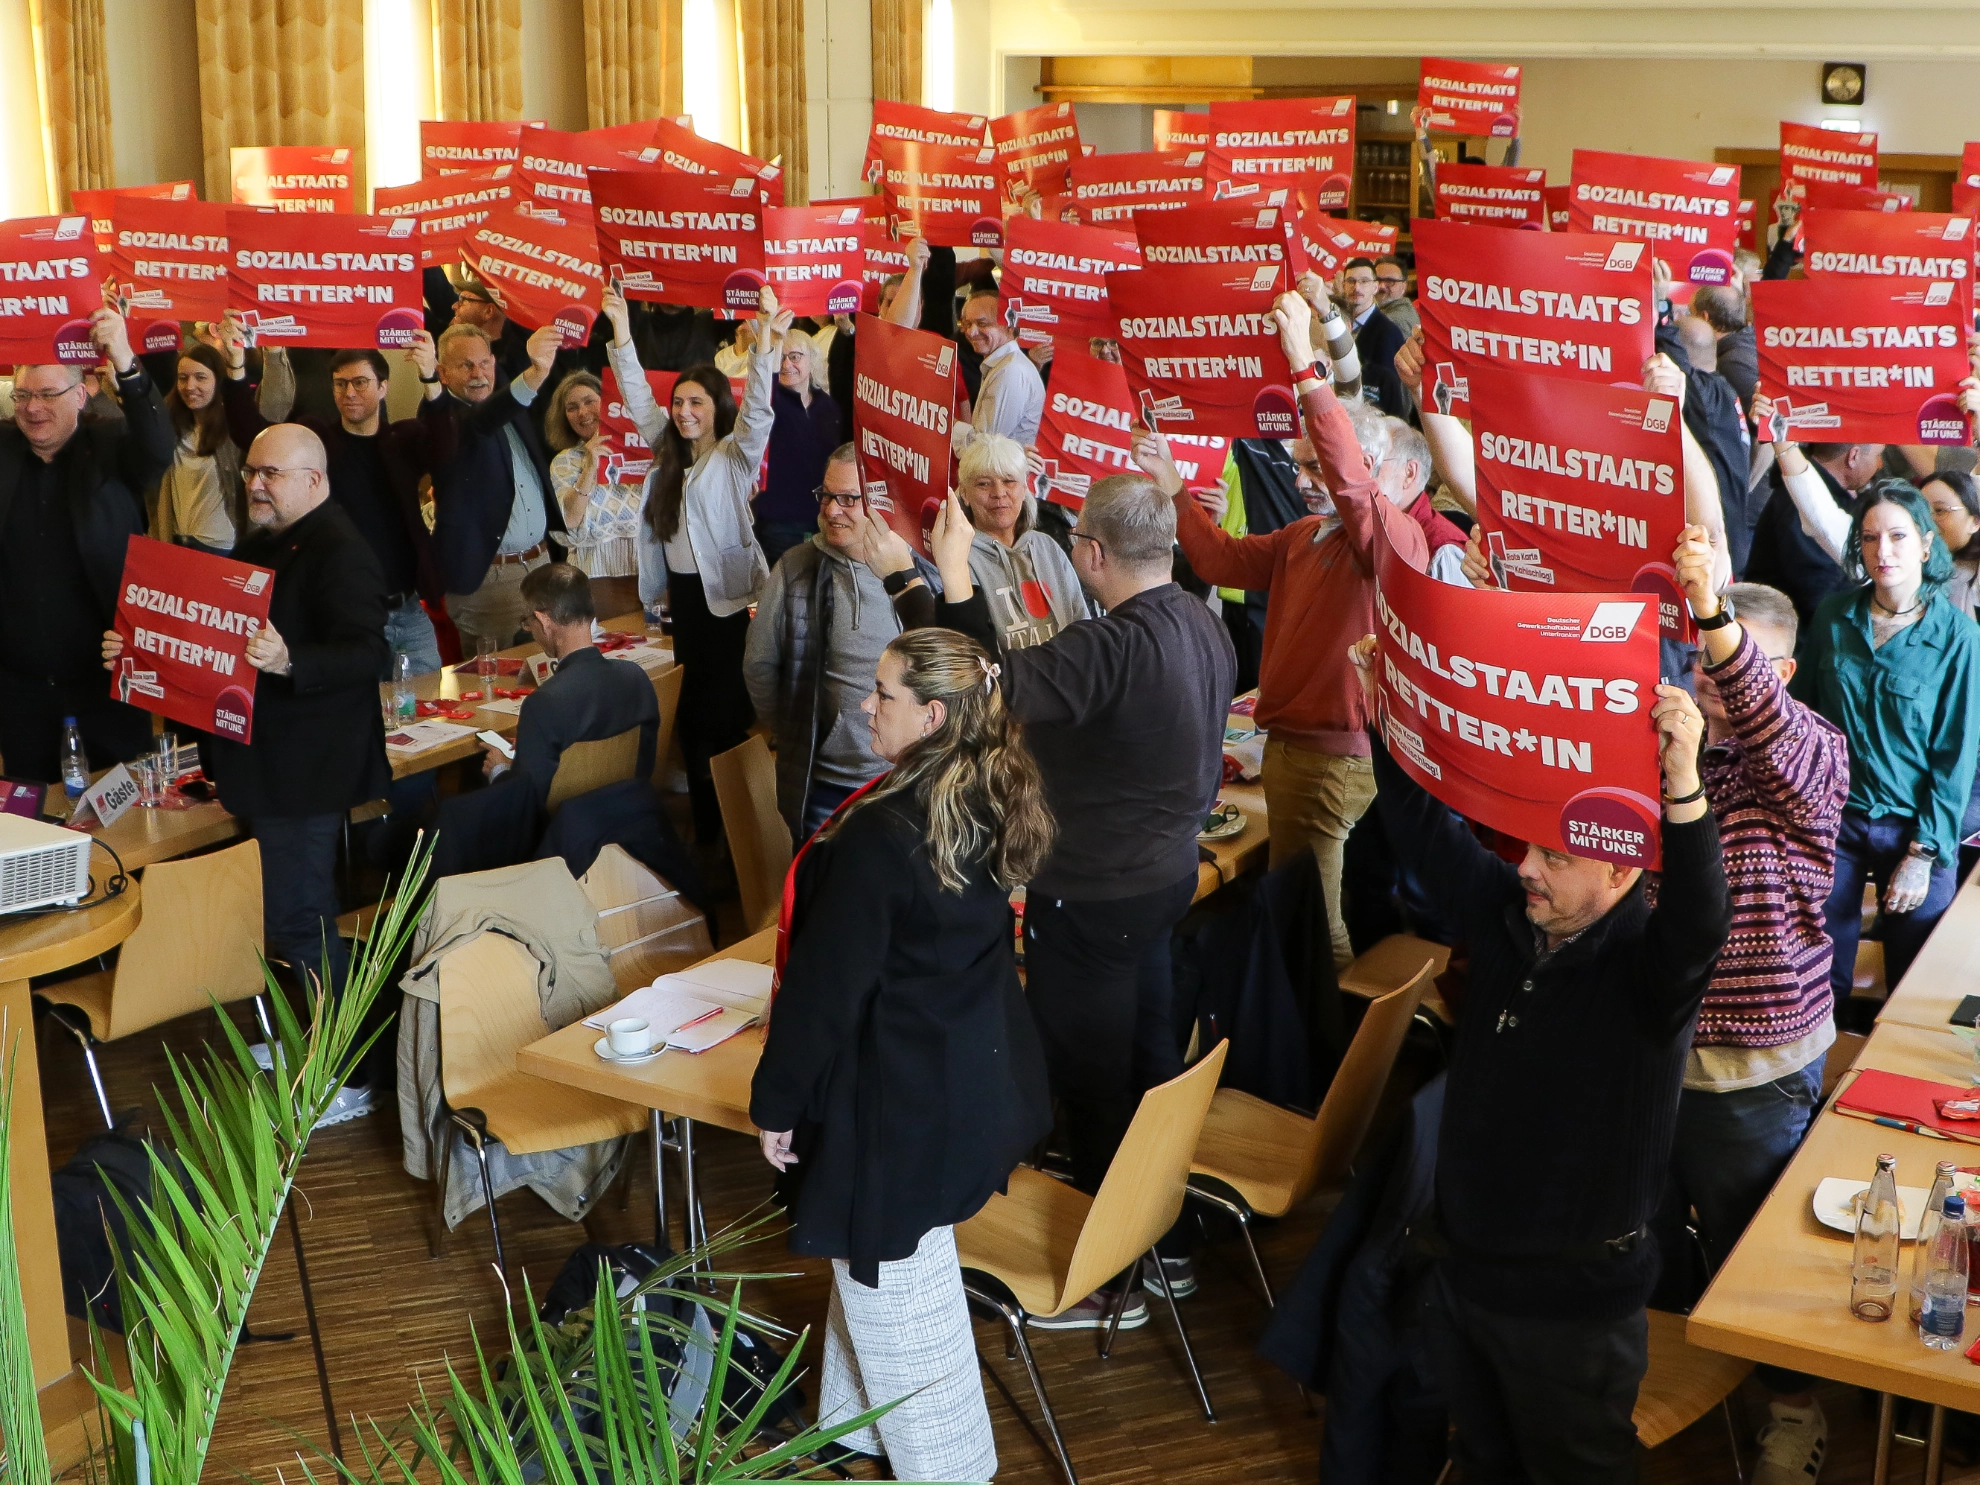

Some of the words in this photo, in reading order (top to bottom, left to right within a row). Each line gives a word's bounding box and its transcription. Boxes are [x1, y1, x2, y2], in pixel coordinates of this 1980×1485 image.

[1424, 76, 1516, 97] SOZIALSTAATS
[875, 123, 980, 146] SOZIALSTAATS
[1215, 129, 1350, 148] SOZIALSTAATS
[1783, 143, 1873, 167] SOZIALSTAATS
[886, 169, 996, 190] SOZIALSTAATS
[733, 188, 749, 196] DGB
[1076, 177, 1205, 199] SOZIALSTAATS
[1439, 183, 1541, 202] SOZIALSTAATS
[1576, 184, 1730, 217] SOZIALSTAATS
[600, 206, 757, 231] SOZIALSTAATS
[1257, 219, 1274, 227] DGB
[57, 229, 78, 238] DGB
[972, 231, 999, 240] STÄRKER
[235, 250, 415, 272] SOZIALSTAATS
[1145, 244, 1284, 264] SOZIALSTAATS
[1609, 259, 1634, 270] DGB
[1691, 265, 1726, 276] STÄRKER
[1810, 251, 1967, 279] SOZIALSTAATS
[637, 272, 651, 280] Karte
[1691, 273, 1704, 282] MIT
[1705, 273, 1724, 283] UNS.
[631, 282, 662, 291] Kahlschlag!
[1253, 281, 1271, 289] DGB
[725, 288, 760, 298] STÄRKER
[829, 295, 857, 305] STÄRKER
[1426, 275, 1642, 325] SOZIALSTAATS
[740, 298, 759, 306] UNS.
[554, 318, 585, 333] STÄRKER
[1119, 314, 1278, 339] SOZIALSTAATS
[565, 326, 582, 341] UNS.
[1763, 325, 1958, 348] SOZIALSTAATS
[58, 340, 95, 350] STÄRKE
[77, 351, 98, 359] UNS.
[937, 363, 950, 375] DGB
[1456, 380, 1468, 388] Rot
[856, 373, 949, 435] SOZIALSTAATS
[1166, 399, 1180, 407] Karte
[1162, 411, 1192, 419] Kahlschlag!
[1256, 411, 1293, 423] STÄRKER
[1258, 423, 1273, 431] MIT
[1274, 423, 1293, 432] UNS.
[1646, 418, 1667, 431] DGB
[1920, 418, 1964, 430] STÄRKER
[1921, 429, 1938, 439] MIT
[1939, 430, 1963, 440] UNS.
[1480, 432, 1674, 495] SOZIALSTAATS
[1506, 552, 1520, 562] Rote
[1521, 553, 1539, 562] Karte
[1514, 566, 1553, 583] Kahlschlag!
[246, 583, 261, 594] DGB
[125, 584, 260, 638] SOZIALSTAATS
[1517, 622, 1580, 631] Gewerkschaftsbund
[1590, 626, 1627, 639] DGB
[216, 708, 246, 725] STÄRKER
[216, 718, 228, 728] MIT
[228, 720, 244, 734] UNS.
[1401, 728, 1422, 748] Karte
[1397, 738, 1438, 777] Kahlschlag!
[105, 778, 136, 811] Gäste
[1568, 819, 1645, 845] STÄRKER
[1570, 833, 1599, 849] MIT
[1601, 838, 1643, 857] UNS.
